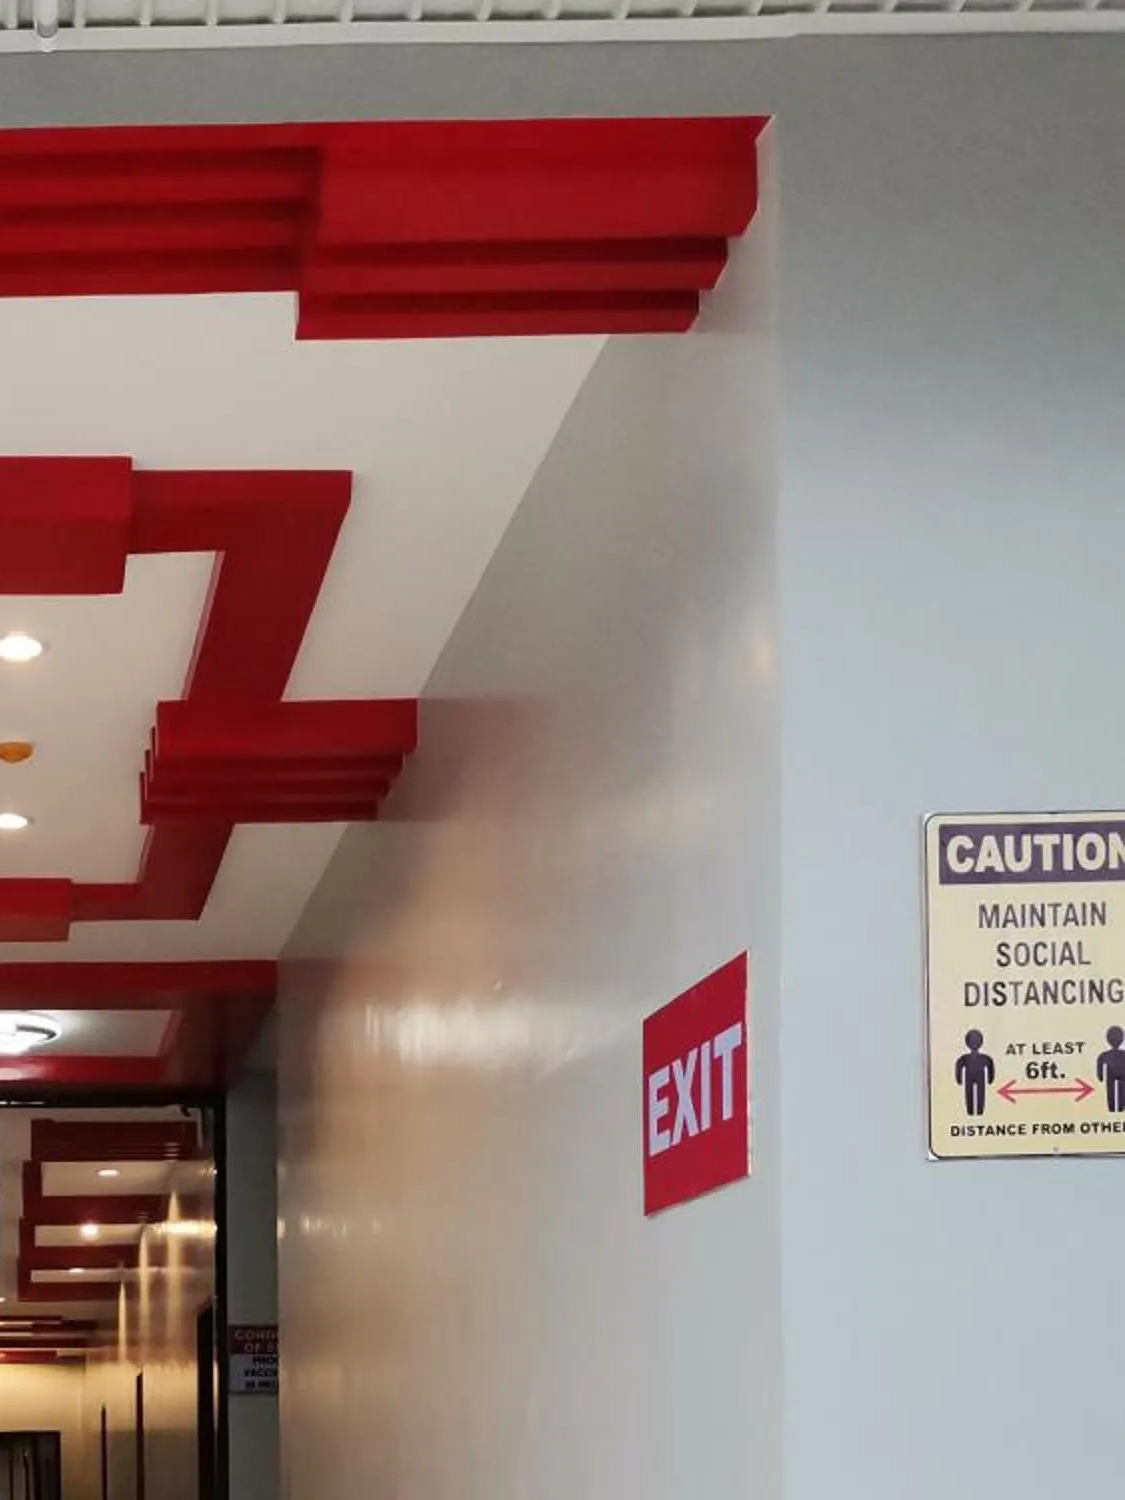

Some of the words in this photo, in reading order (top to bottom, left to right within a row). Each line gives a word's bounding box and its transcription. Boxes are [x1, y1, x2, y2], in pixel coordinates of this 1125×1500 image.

[946, 832, 1125, 873] CAUTION
[978, 901, 1107, 929] MAINTAIN
[996, 941, 1091, 968] SOCIAL
[964, 978, 1124, 1007] DISTANCING
[1005, 1043, 1025, 1055] AT
[1032, 1041, 1086, 1055] LEAST
[1026, 1061, 1066, 1080] 6ft.
[648, 1021, 742, 1157] EXIT
[950, 1123, 1027, 1137] DISTANCE
[1032, 1122, 1075, 1136] FROM
